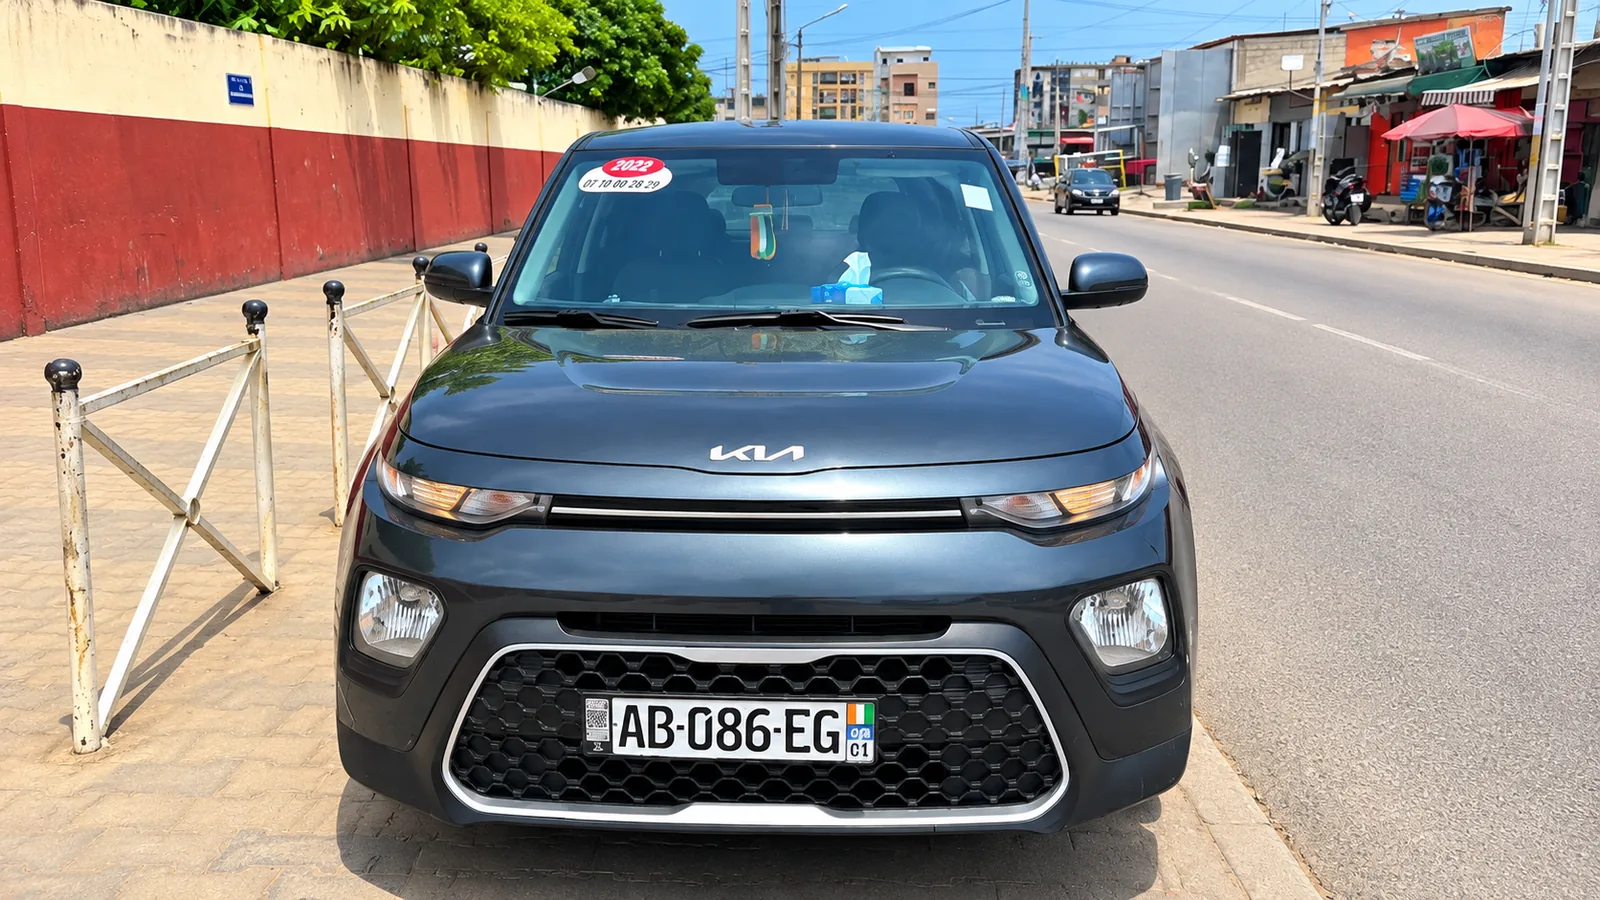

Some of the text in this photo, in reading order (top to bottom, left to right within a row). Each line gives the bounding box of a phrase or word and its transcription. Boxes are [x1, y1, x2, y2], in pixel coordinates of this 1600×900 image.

[610, 159, 654, 172] 2022
[582, 179, 598, 188] 07
[598, 179, 612, 188] 10
[613, 179, 628, 189] 00
[644, 180, 660, 190] 29
[710, 445, 804, 461] KIA
[618, 704, 840, 755] AB-086-EG
[850, 742, 869, 758] C1
